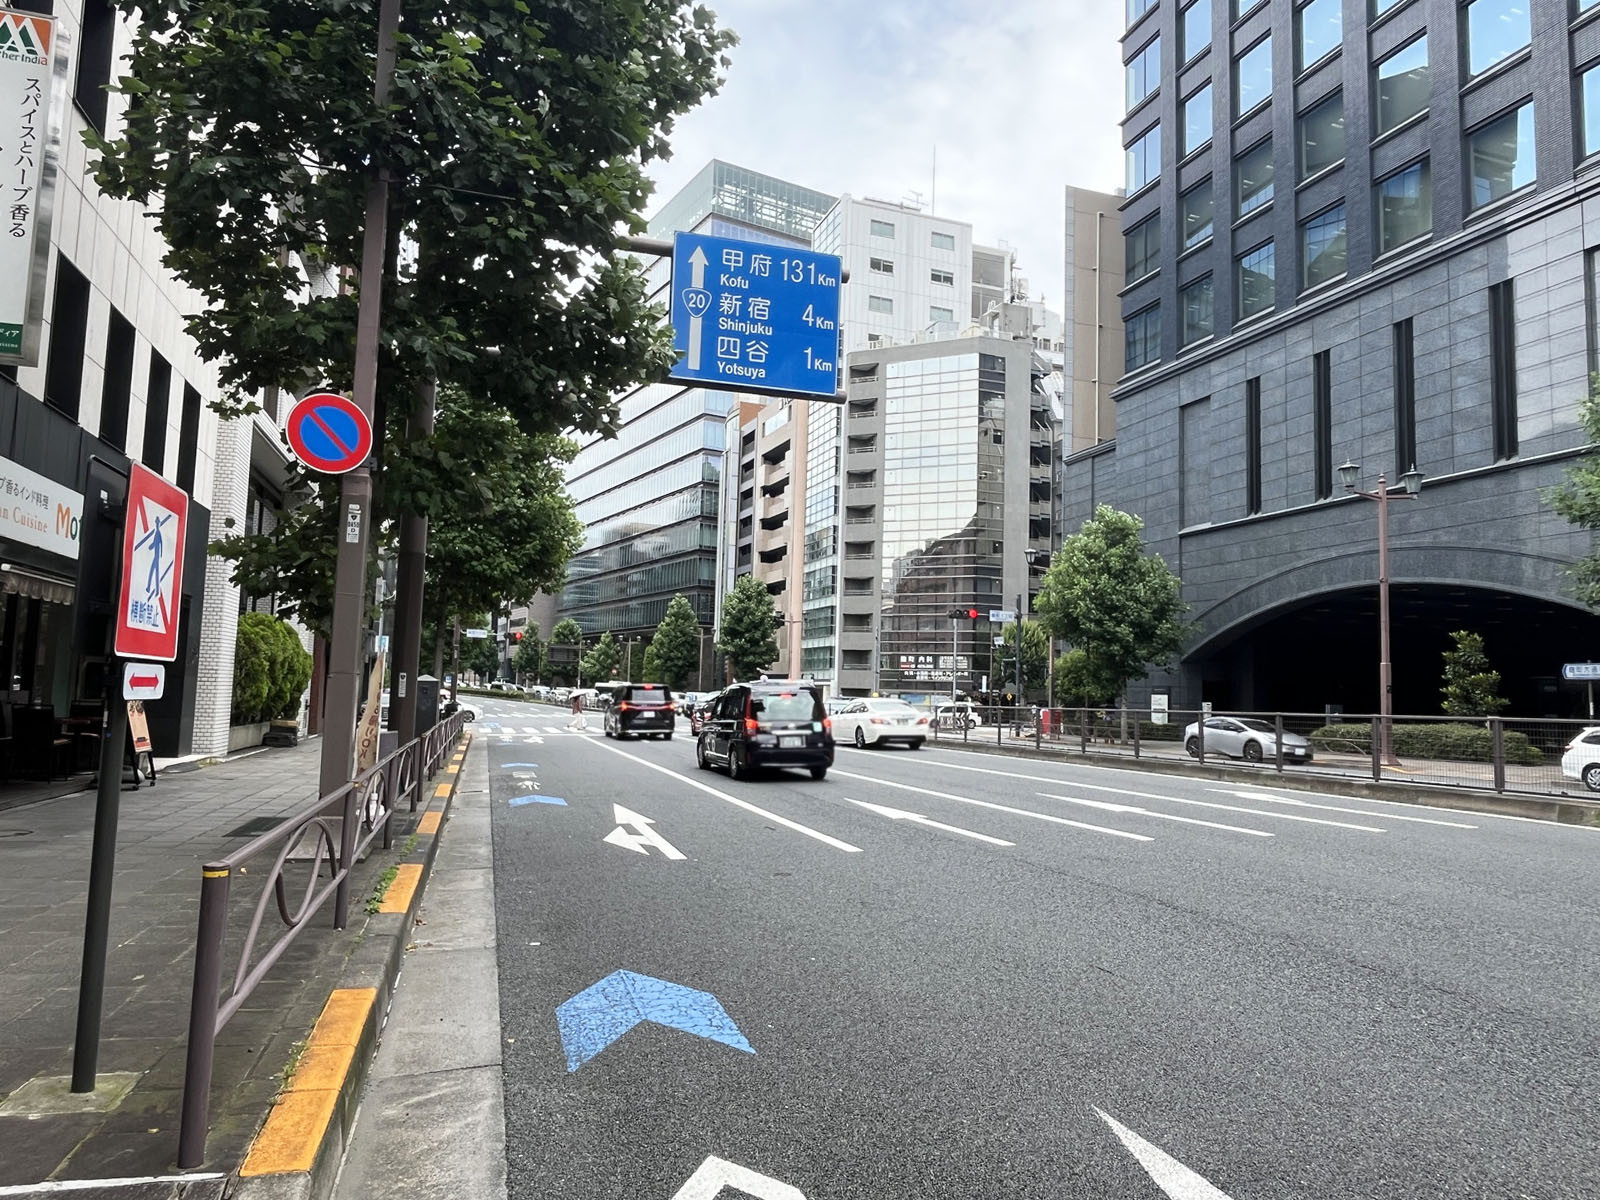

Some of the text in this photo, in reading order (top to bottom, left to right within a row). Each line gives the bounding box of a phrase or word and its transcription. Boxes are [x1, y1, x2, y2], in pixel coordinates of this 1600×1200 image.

[9, 77, 41, 238] スパイスとハーブ香る
[722, 248, 773, 277] 甲府
[720, 273, 749, 289] Kofu
[688, 293, 706, 309] 20
[719, 292, 771, 320] 新宿
[718, 317, 773, 336] Shinjuku
[717, 335, 769, 363] 四谷
[717, 360, 766, 380] Yotsuya
[13, 506, 48, 533] Cuisine
[56, 503, 82, 541] Mo
